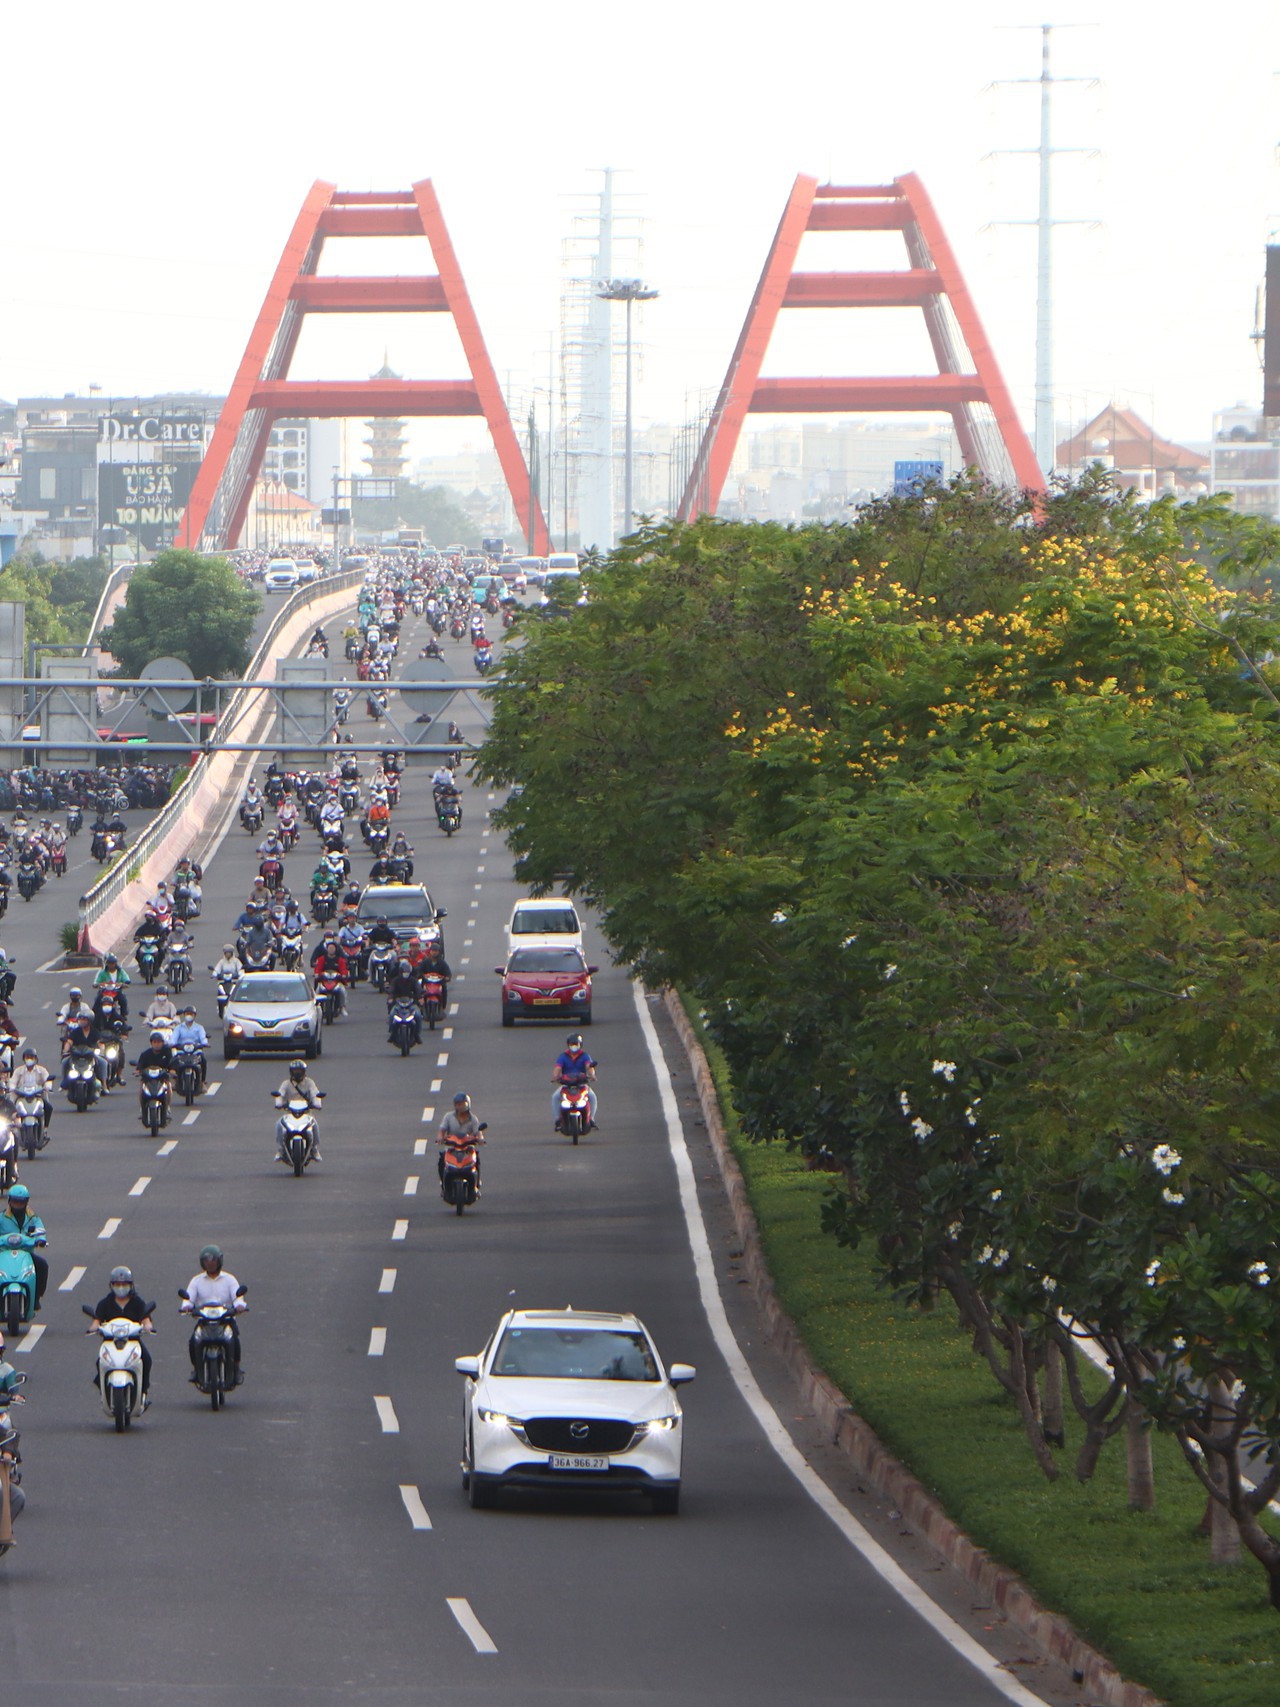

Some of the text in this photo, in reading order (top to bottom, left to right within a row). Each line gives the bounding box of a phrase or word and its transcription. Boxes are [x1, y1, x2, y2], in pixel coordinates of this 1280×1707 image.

[102, 418, 200, 440] Dr.Care
[127, 475, 173, 494] USA
[116, 508, 138, 524] 10
